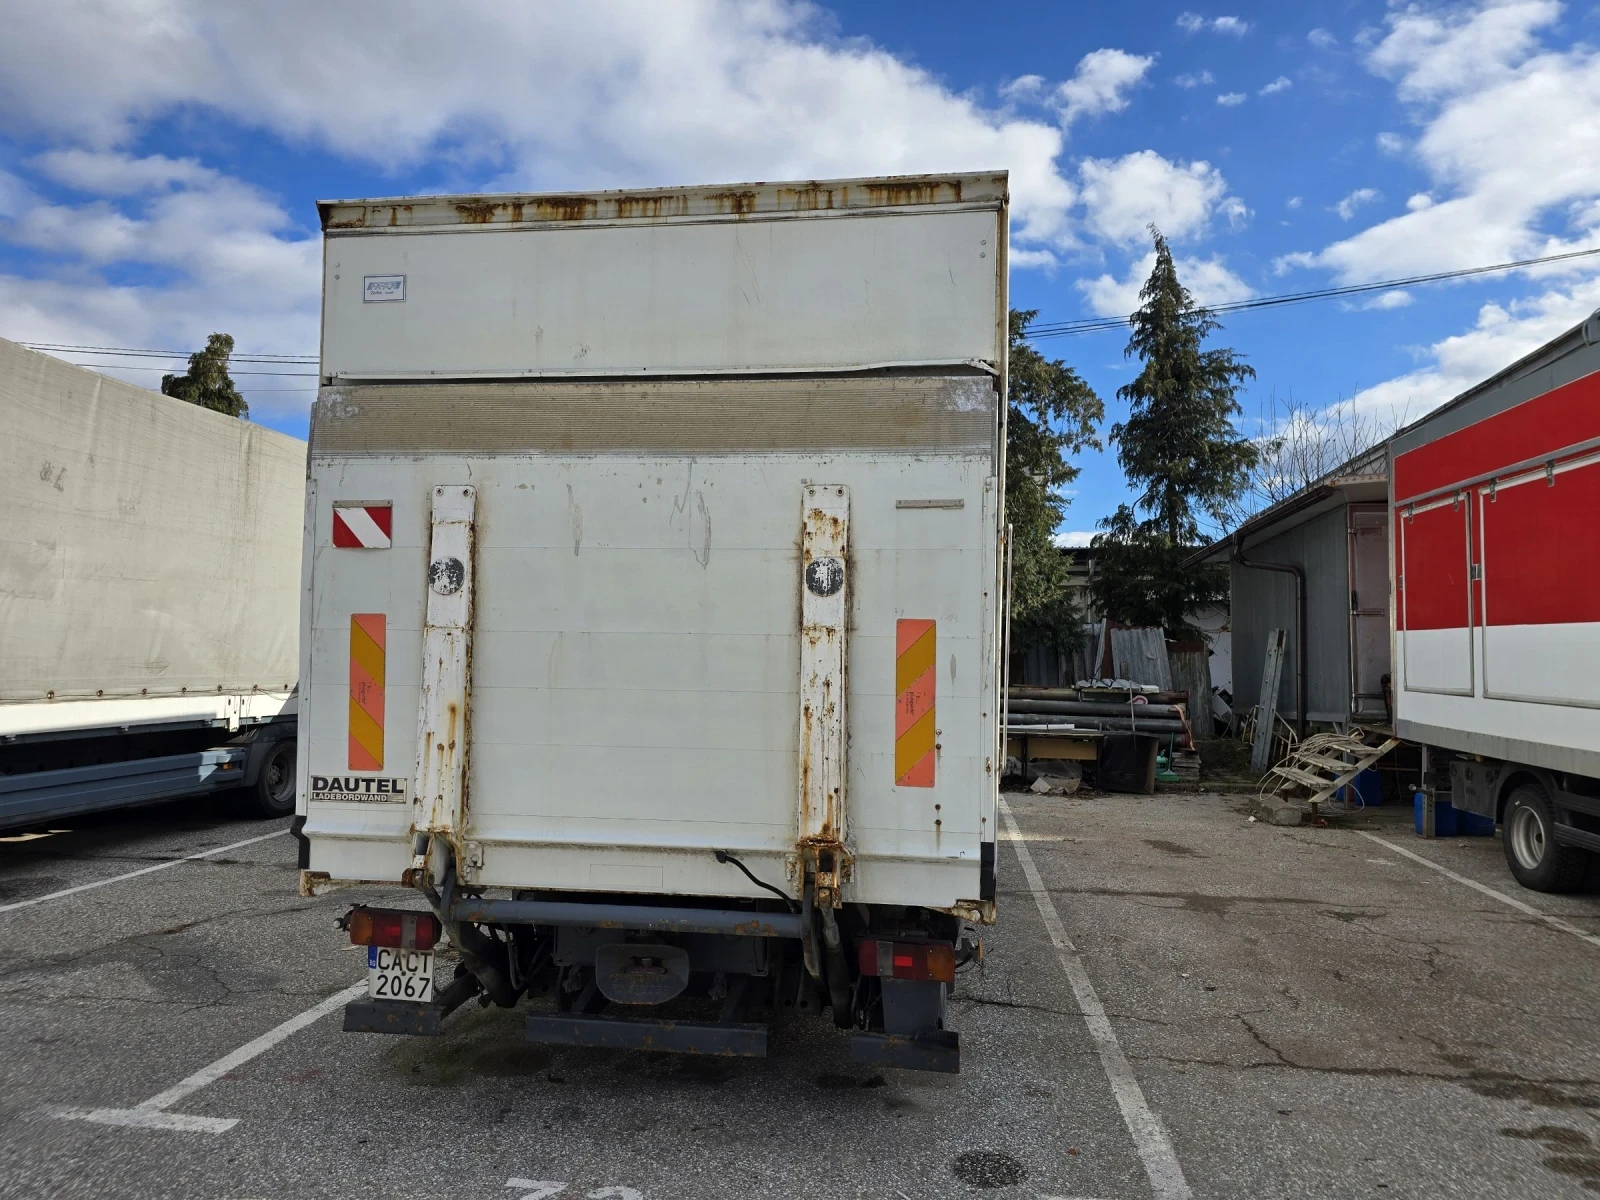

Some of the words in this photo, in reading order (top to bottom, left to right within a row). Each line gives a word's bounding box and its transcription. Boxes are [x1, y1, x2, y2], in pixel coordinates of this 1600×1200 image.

[312, 777, 404, 793] DAUTEL
[313, 793, 387, 801] LADEBORDWAND
[378, 949, 433, 973] CACT
[376, 974, 430, 998] 2067
